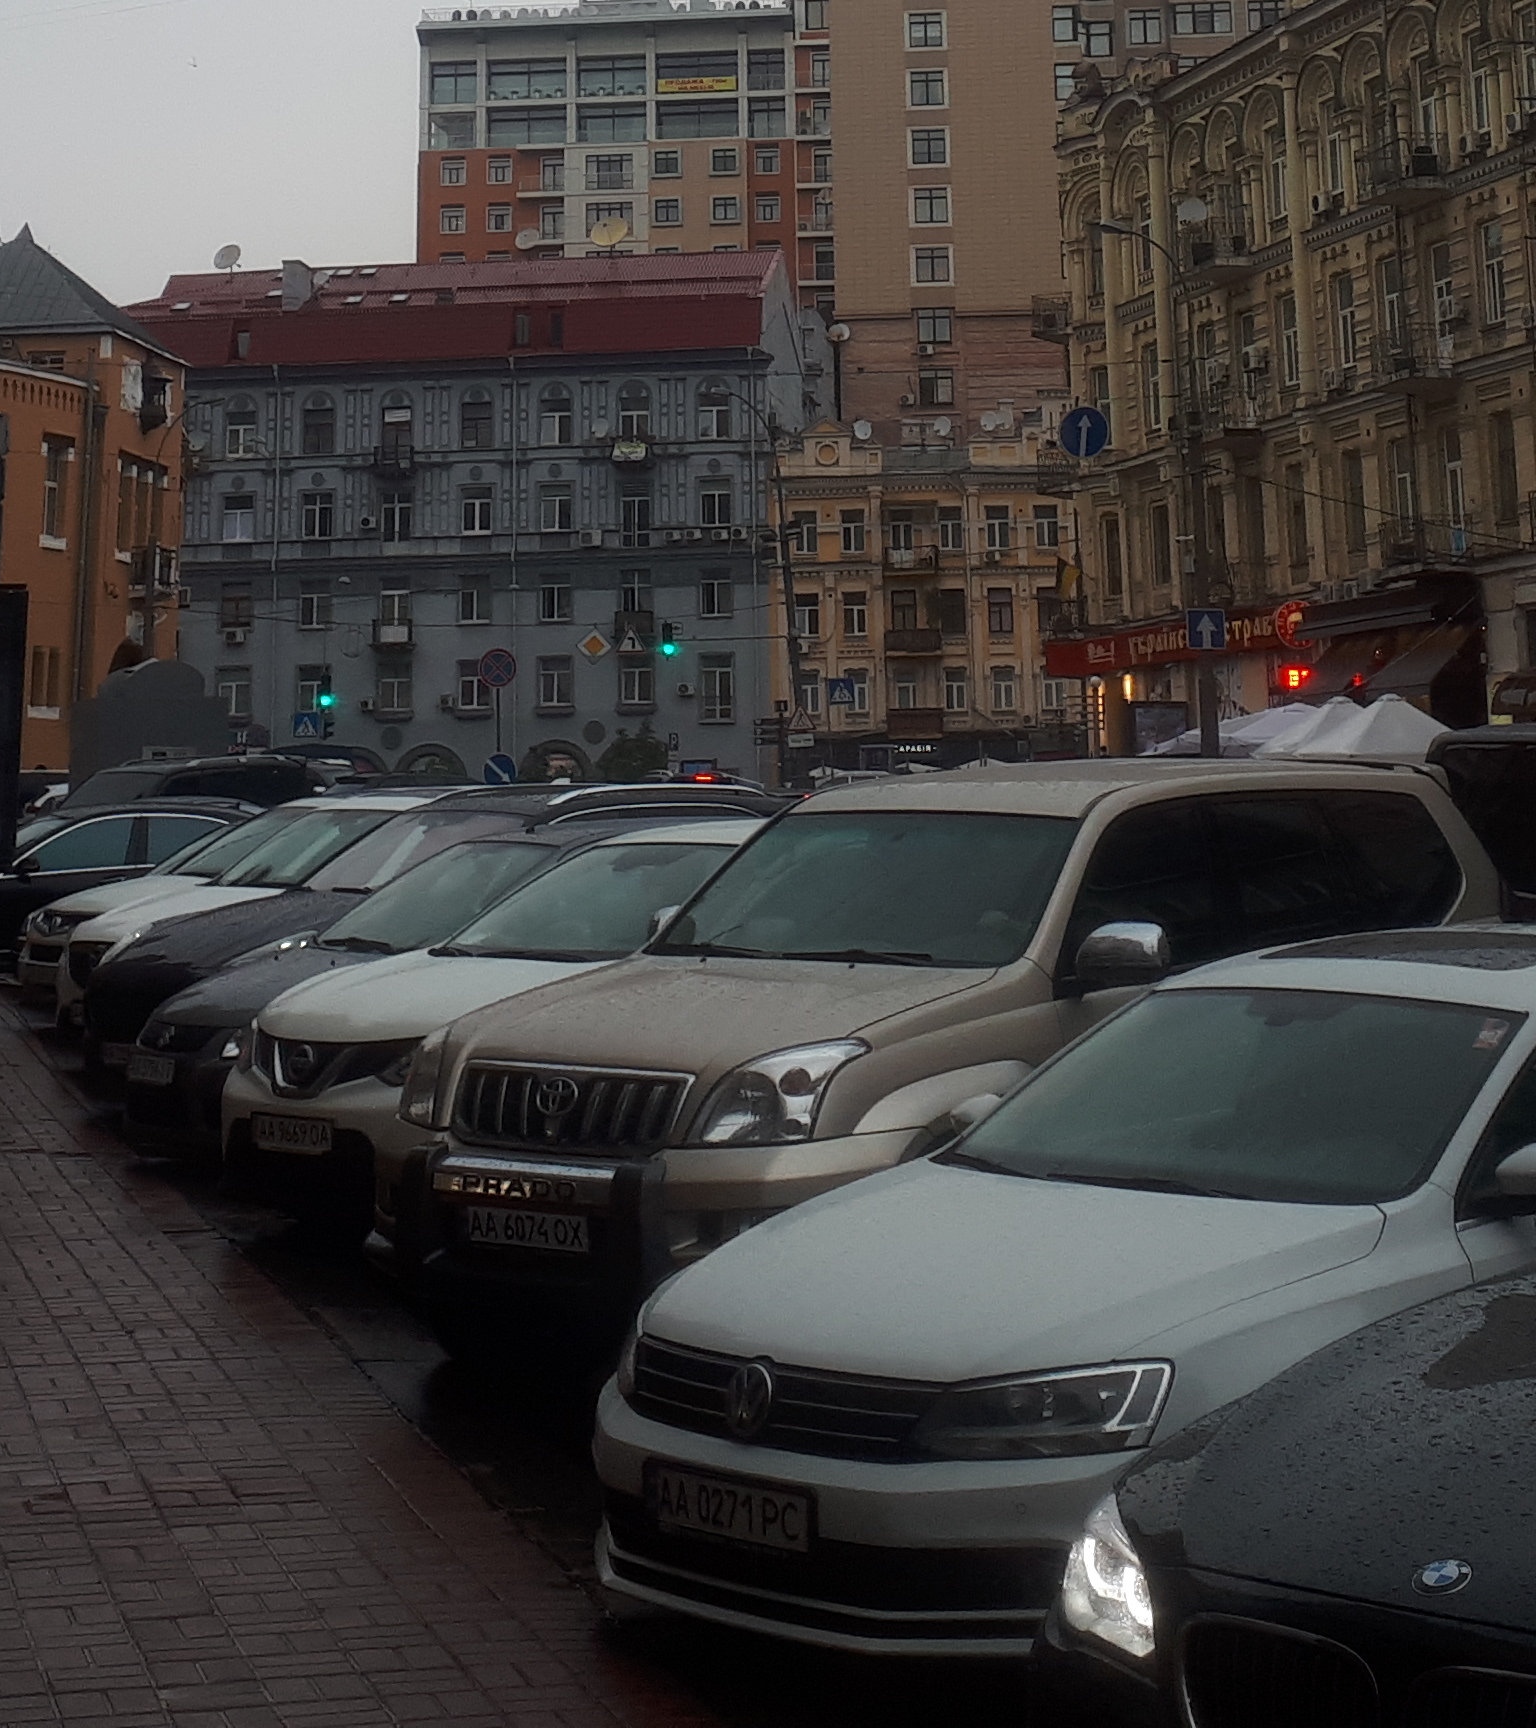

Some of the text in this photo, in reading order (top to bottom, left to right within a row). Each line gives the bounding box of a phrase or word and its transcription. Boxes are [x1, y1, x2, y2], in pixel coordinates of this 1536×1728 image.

[471, 1210, 584, 1248] AA 6074 OX
[662, 1477, 801, 1541] AA 0271 PC
